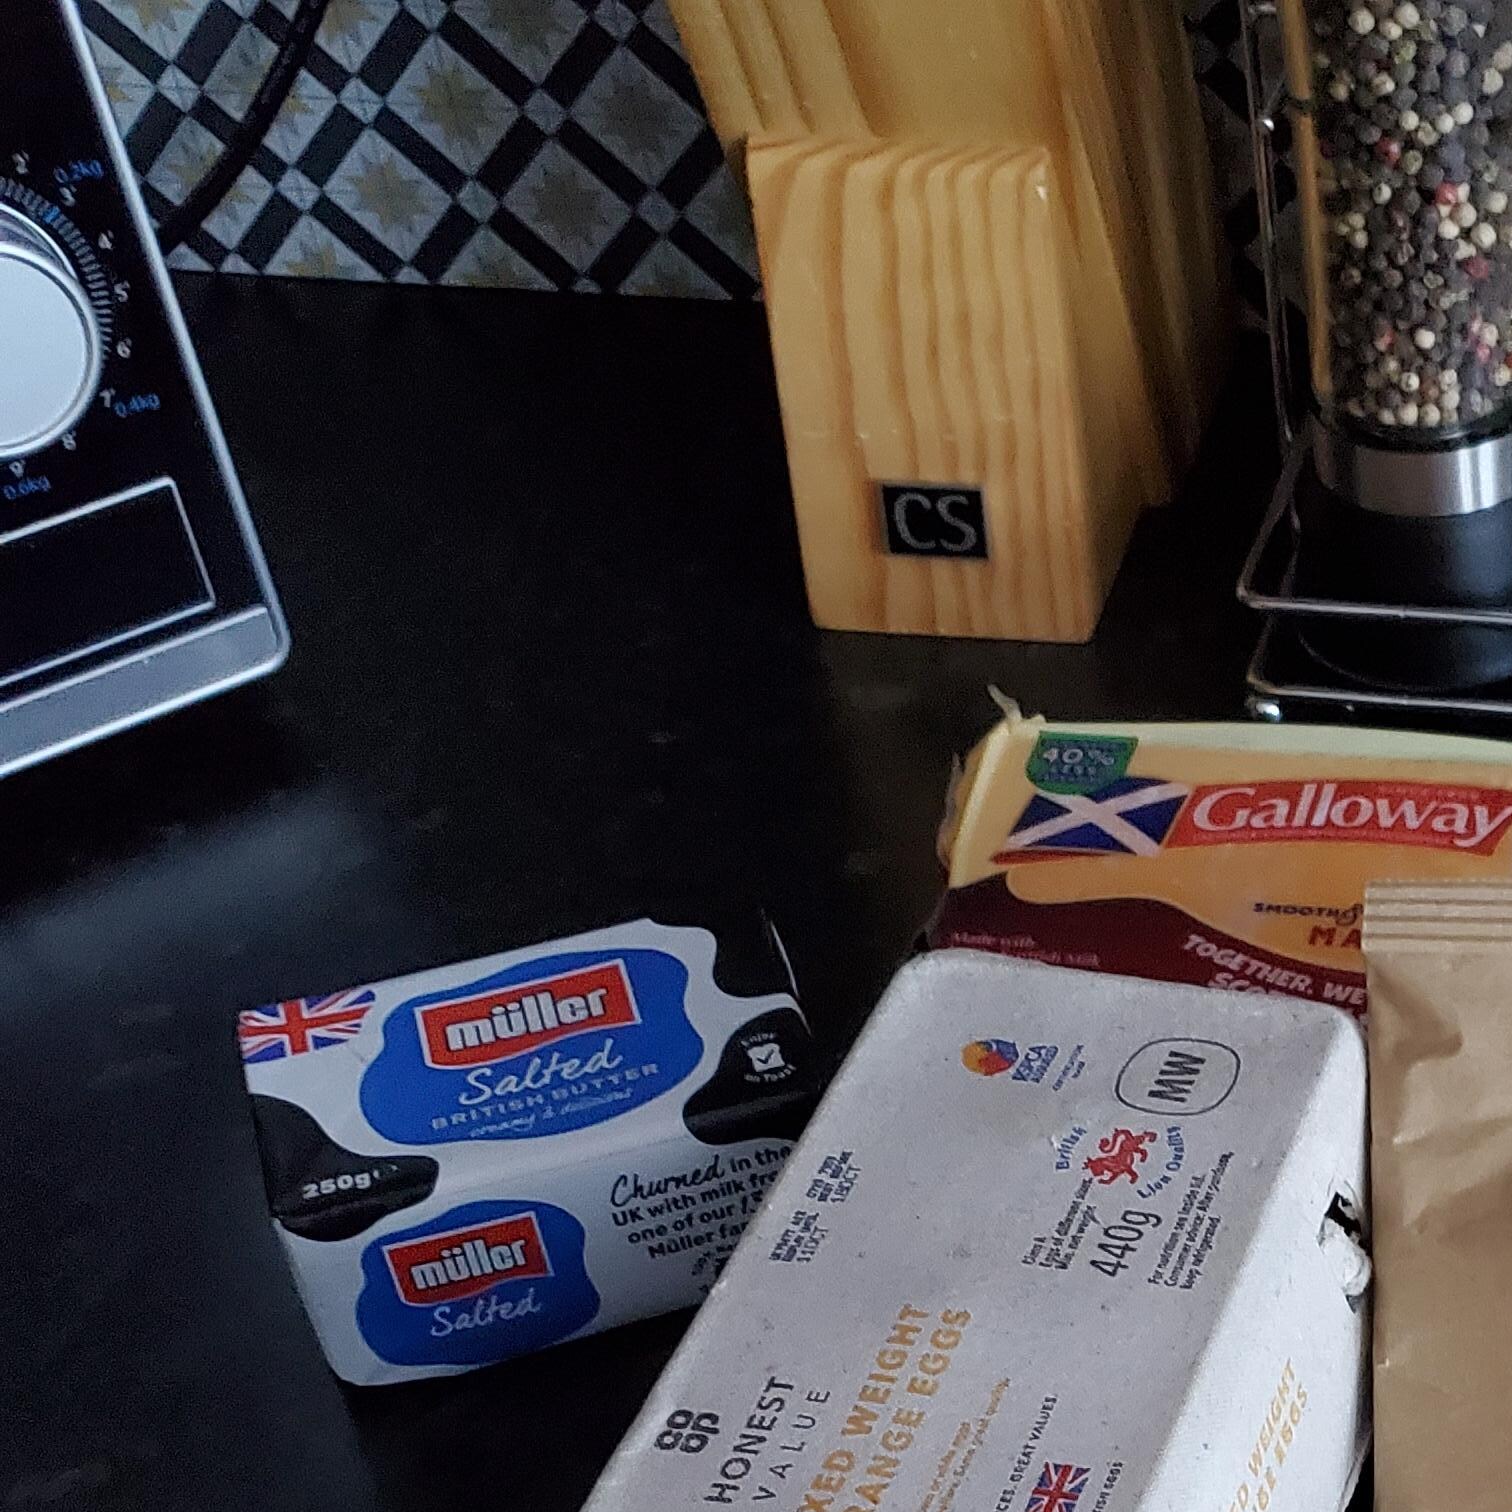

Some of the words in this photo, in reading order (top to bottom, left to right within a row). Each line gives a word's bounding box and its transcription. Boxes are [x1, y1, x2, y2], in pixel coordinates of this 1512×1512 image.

[893, 491, 978, 552] CS
[1182, 934, 1314, 994] TOGETHER.
[1307, 924, 1362, 950] MA
[444, 987, 609, 1052] müller
[431, 1093, 544, 1130] BRITISH
[551, 1063, 659, 1100] BUTTER
[458, 1037, 624, 1107] Salted
[1147, 1050, 1207, 1103] MW
[301, 1171, 372, 1200] 250g
[610, 1154, 726, 1208] Churned
[729, 1157, 752, 1173] in
[754, 1144, 792, 1167] the
[611, 1208, 644, 1227] UK
[647, 1192, 696, 1218] with
[700, 1180, 746, 1203] milk
[627, 1224, 668, 1244] one
[672, 1211, 697, 1231] of
[699, 1204, 735, 1225] our
[647, 1231, 716, 1259] Müller
[1090, 1209, 1162, 1278] 440g
[409, 1238, 527, 1291] müller
[429, 1286, 542, 1338] Salted
[840, 1303, 930, 1437] WEIGHT
[905, 1307, 973, 1397] EGGS
[703, 1375, 795, 1504] HONEST
[751, 1390, 831, 1501] VALUE
[1248, 1358, 1295, 1478] WEIGHT
[1274, 1383, 1308, 1467] EGGS
[1009, 1442, 1037, 1484] GREAT
